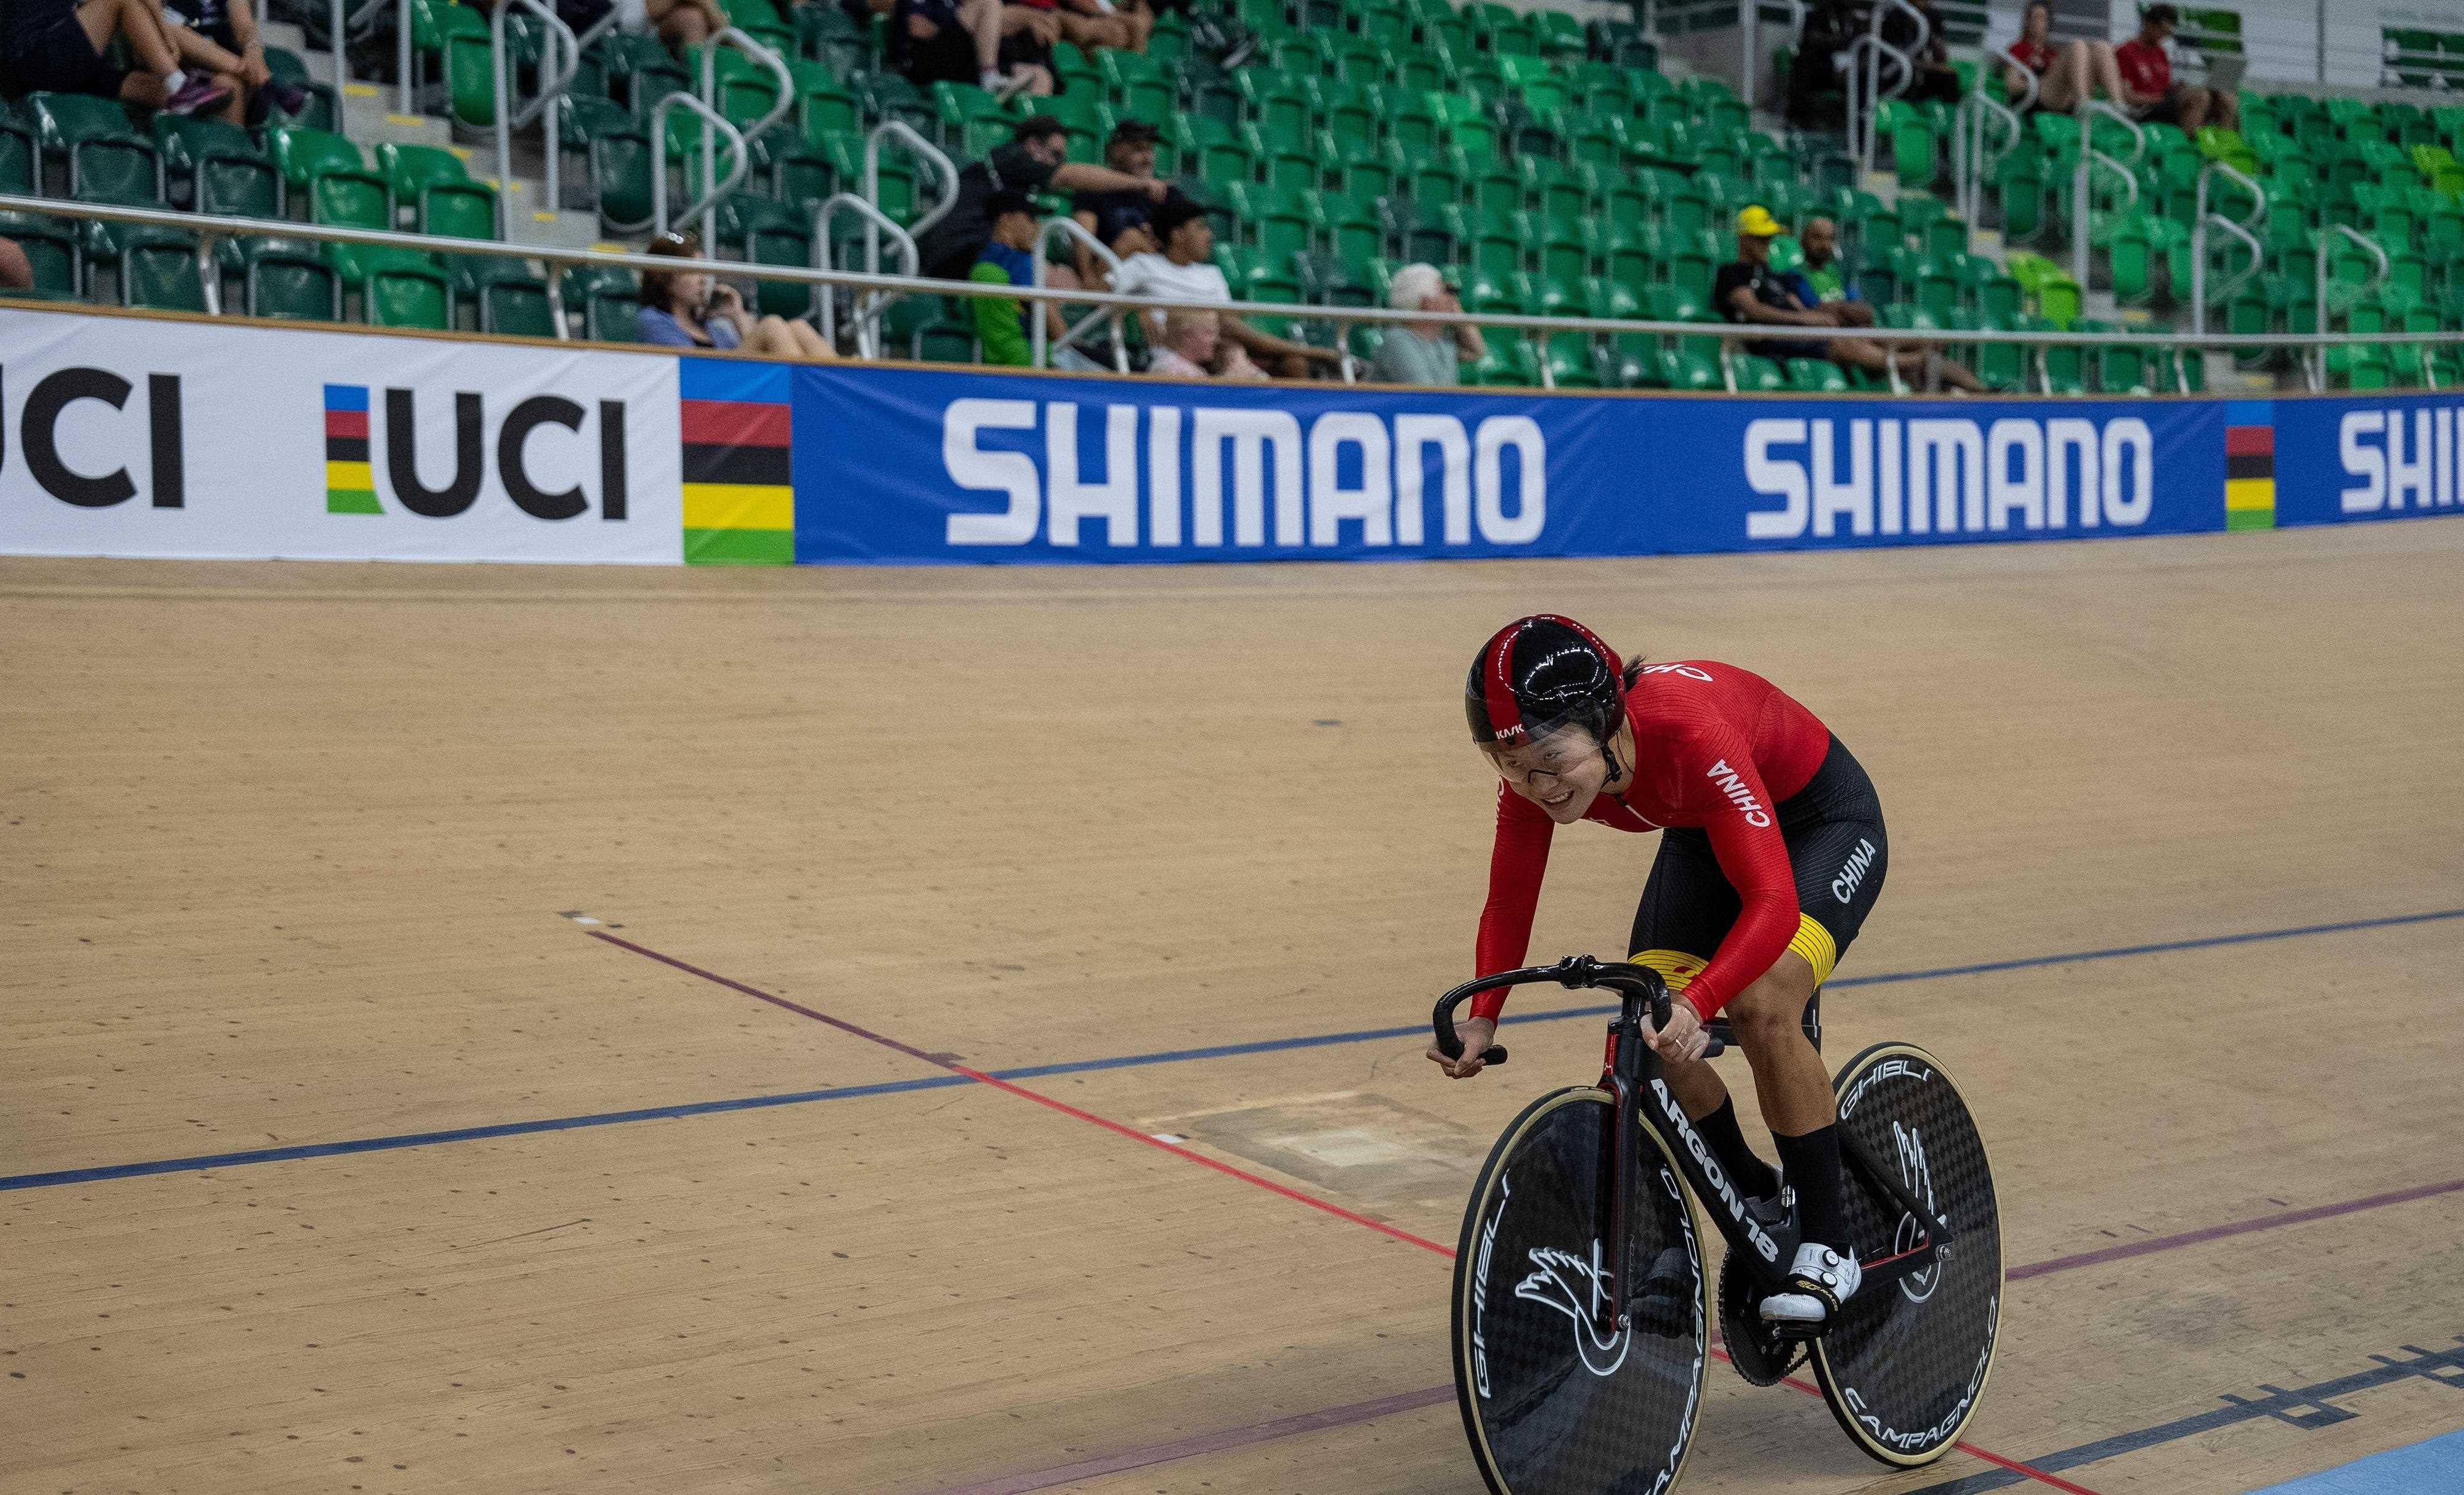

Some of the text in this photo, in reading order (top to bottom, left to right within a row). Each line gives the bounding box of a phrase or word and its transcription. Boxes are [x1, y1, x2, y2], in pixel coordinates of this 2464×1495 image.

[0, 364, 184, 509] CI
[386, 388, 627, 521] UCI
[942, 397, 1546, 546] SHIMANO
[1743, 418, 2153, 540] SHIMANO
[2340, 408, 2464, 513] SHI
[1495, 723, 1525, 740] KASK
[1706, 758, 1771, 828] CHINA
[1831, 838, 1876, 904] CHINA
[1839, 1059, 1934, 1127] GHIBLI
[1650, 1077, 1780, 1263] ARGON 18
[1473, 1167, 1511, 1399] GHIBLI
[1644, 1167, 1704, 1495] AMPAGNOLO
[1844, 1294, 1996, 1449] CAMPAGNOLO
